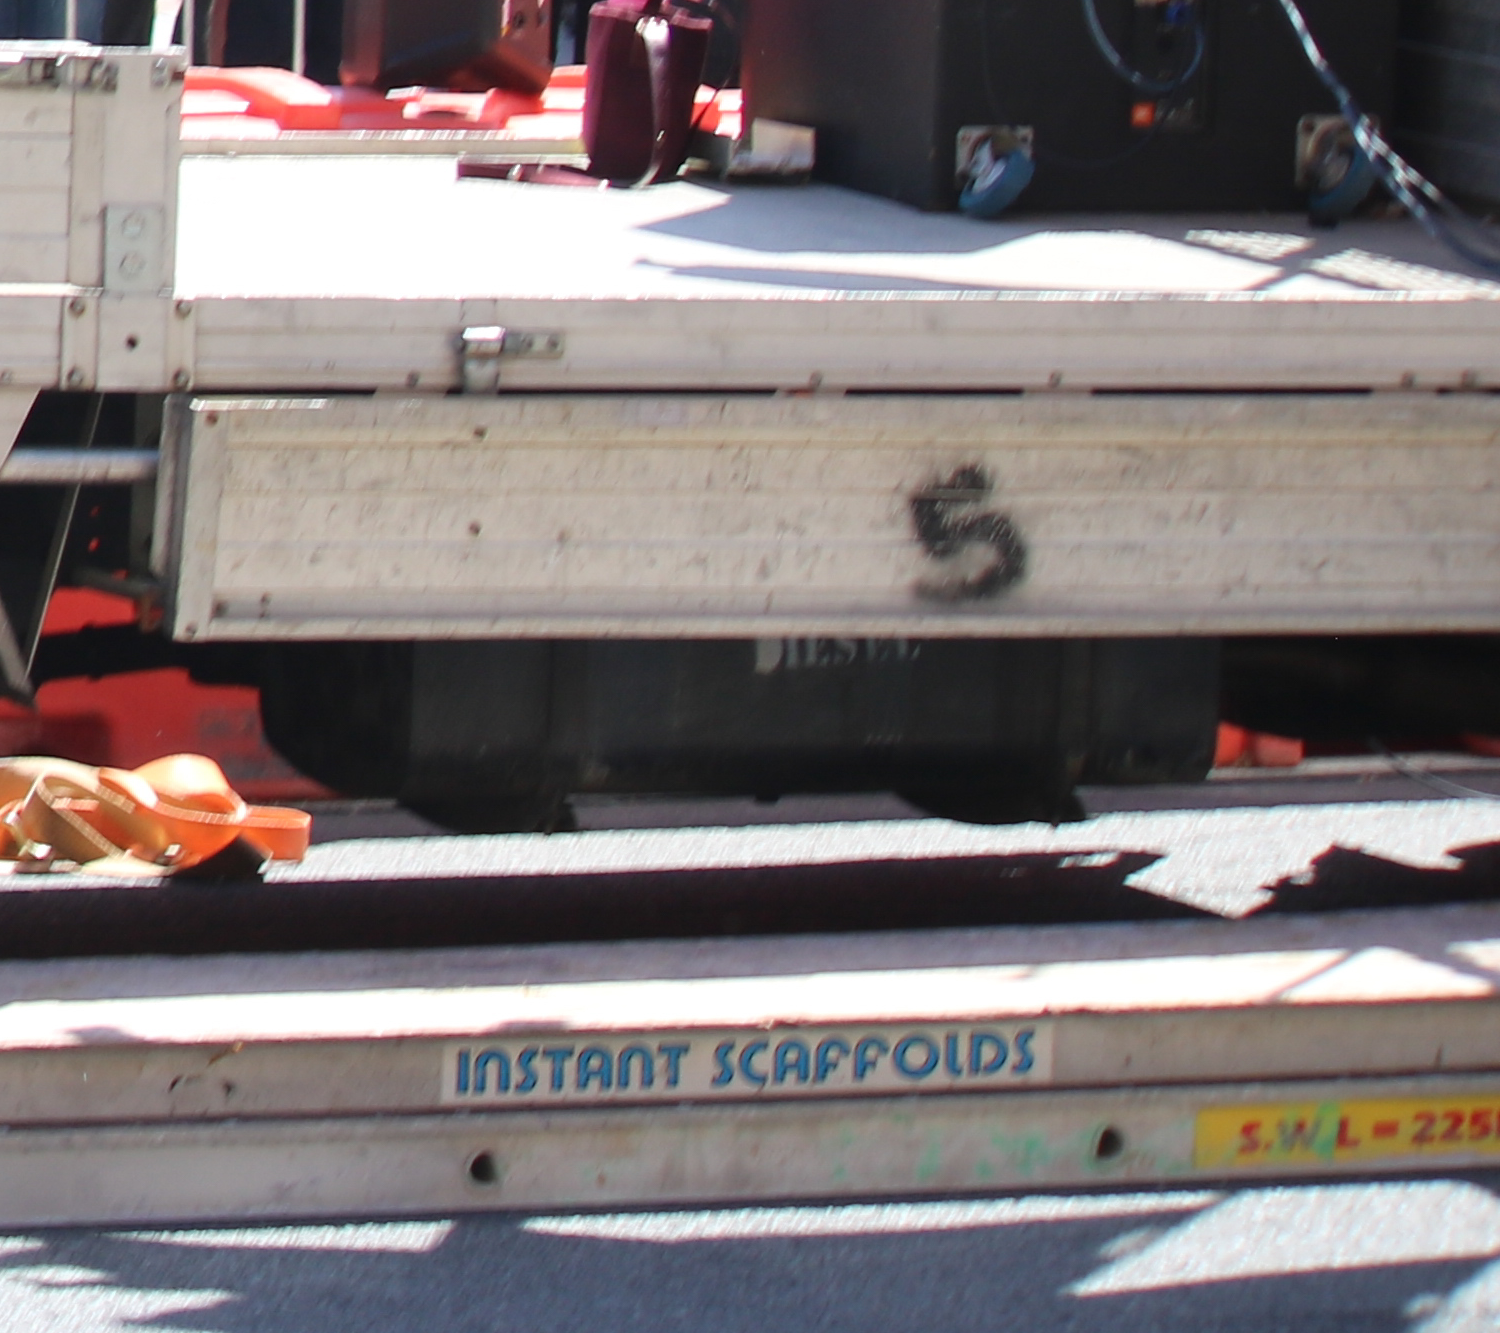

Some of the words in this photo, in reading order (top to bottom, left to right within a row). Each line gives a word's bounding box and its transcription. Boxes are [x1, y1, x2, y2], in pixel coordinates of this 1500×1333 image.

[453, 1040, 692, 1098] INSTANT
[710, 1027, 1037, 1089] SCAFFOLDS
[1411, 1107, 1500, 1147] 225
